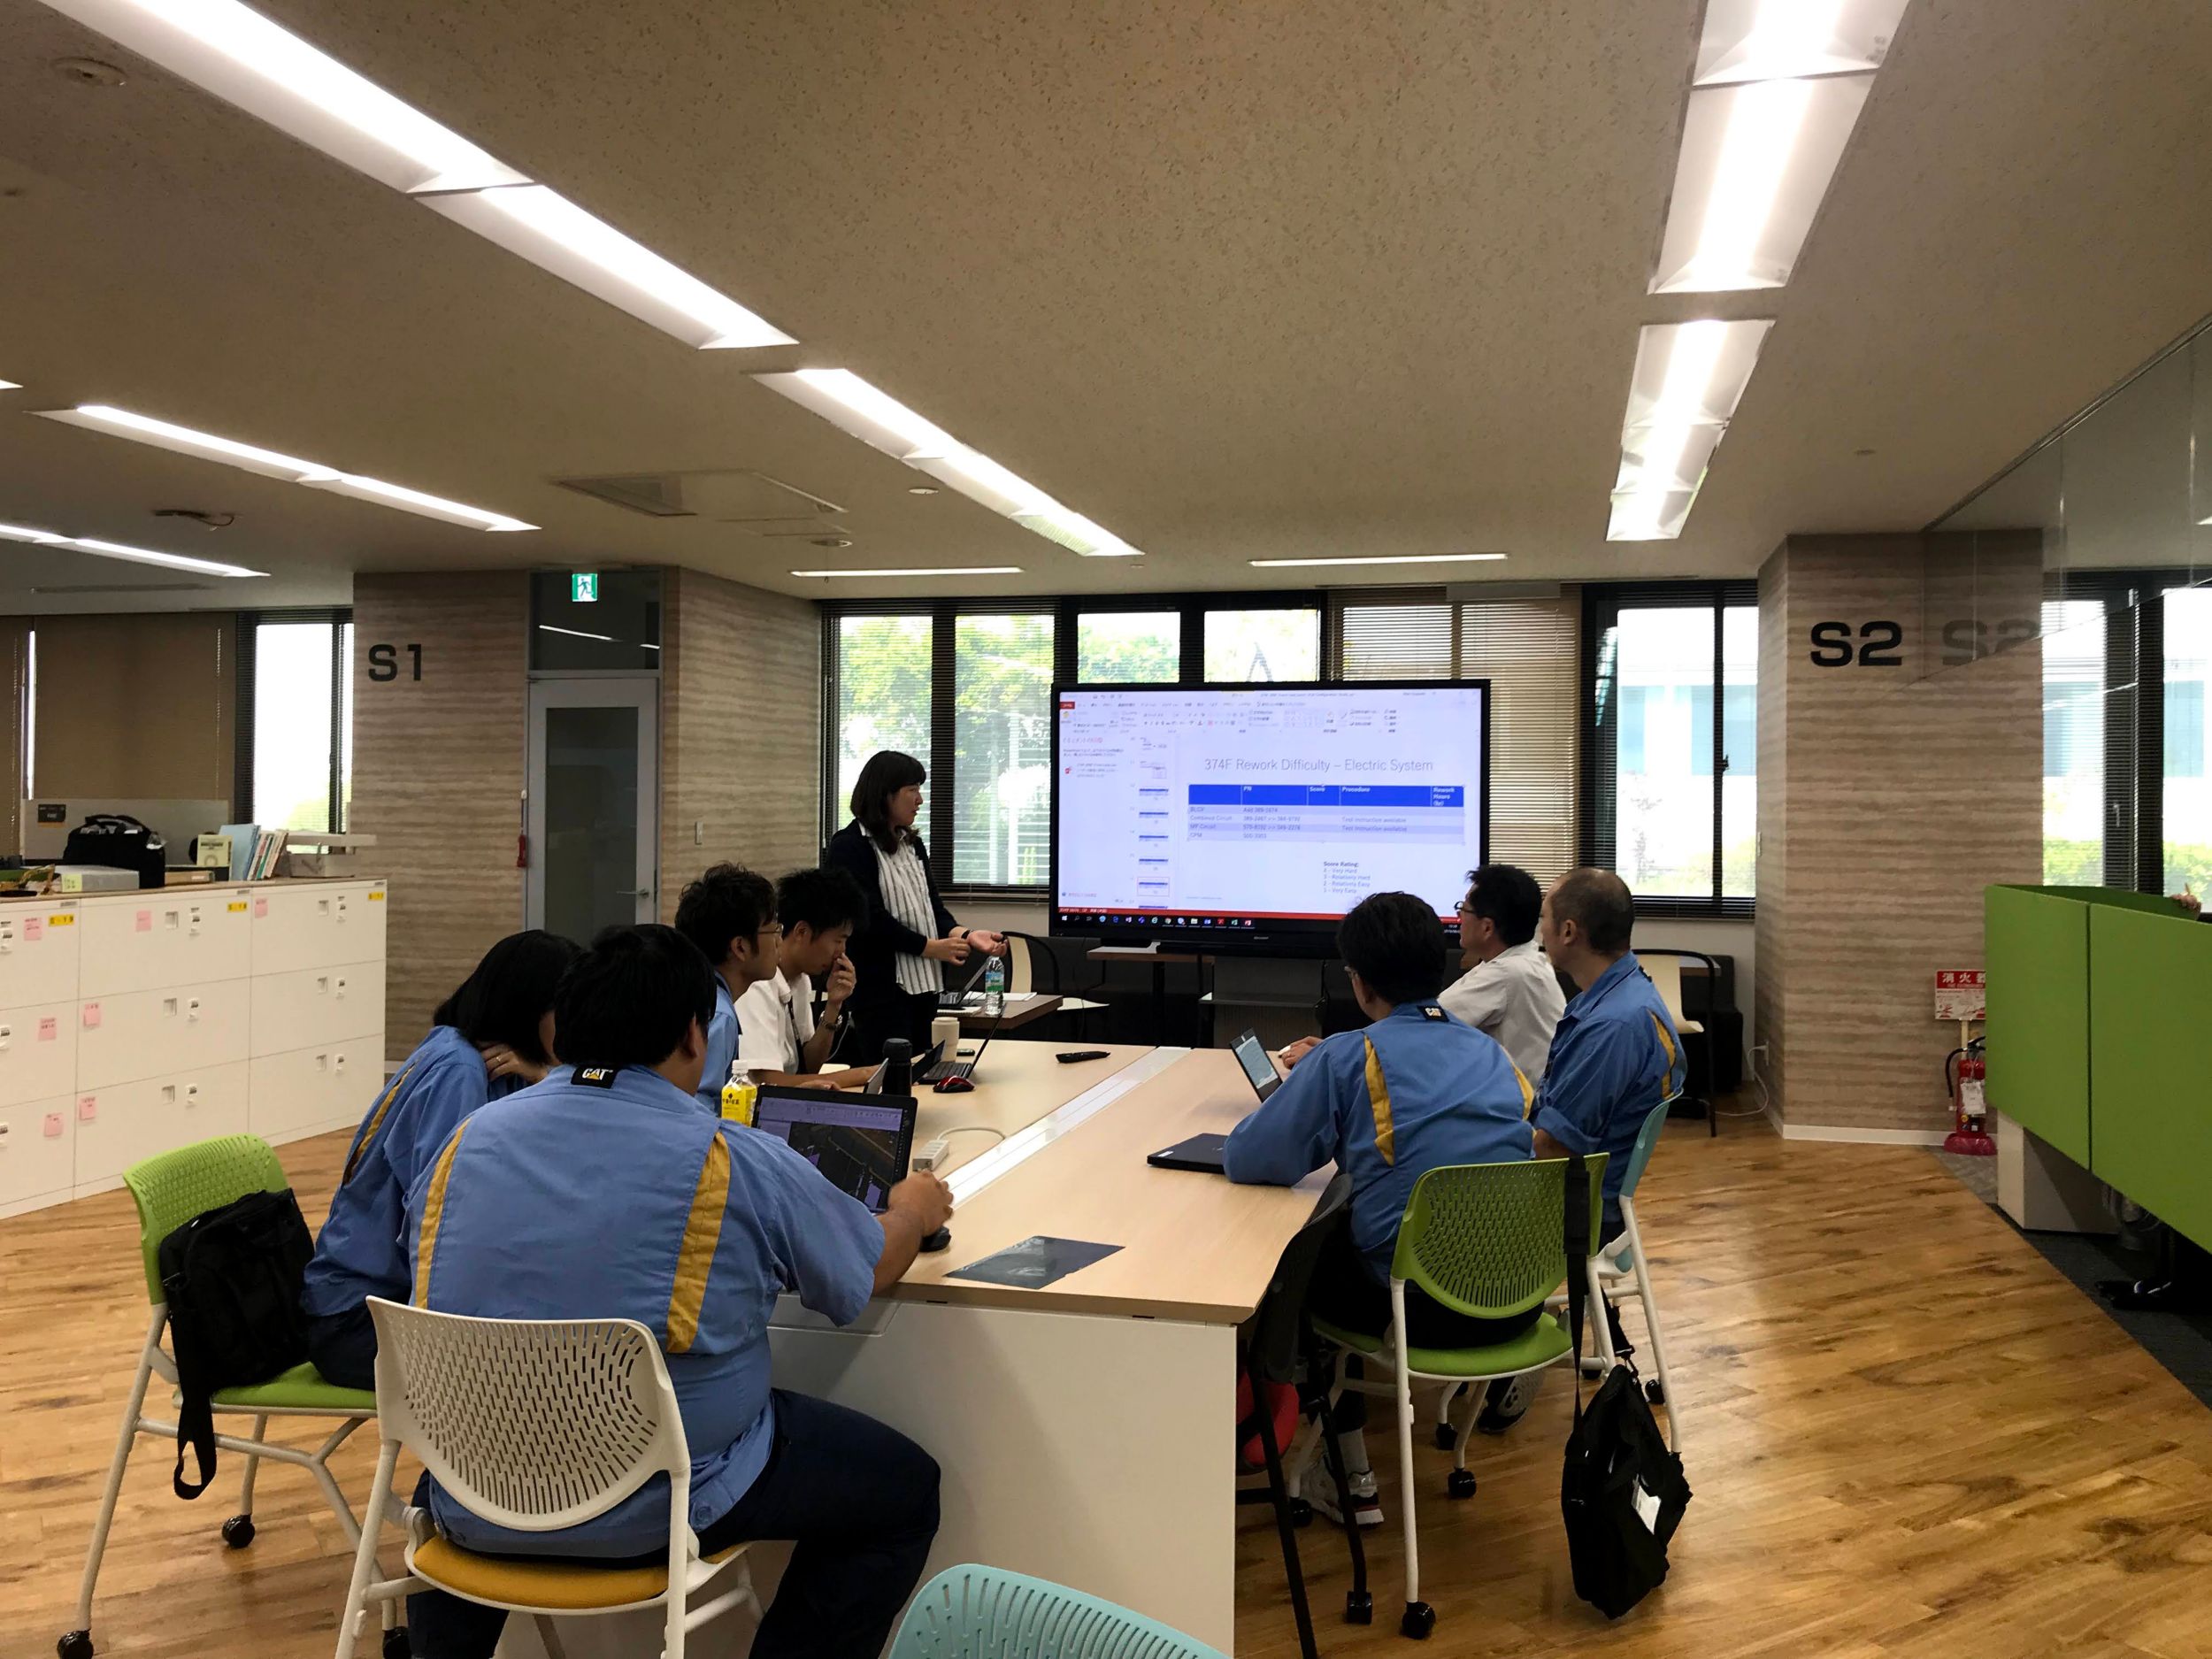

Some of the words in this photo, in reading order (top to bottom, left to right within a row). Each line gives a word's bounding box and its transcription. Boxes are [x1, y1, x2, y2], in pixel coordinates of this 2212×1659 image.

[1810, 621, 1903, 667] S2
[369, 644, 423, 680] S1
[1204, 758, 1233, 771] 374F
[1236, 758, 1278, 771] Rework
[1281, 758, 1331, 773] Difficulty
[1345, 758, 1386, 771] Electric
[1390, 758, 1433, 773] System
[581, 1067, 611, 1081] CAT
